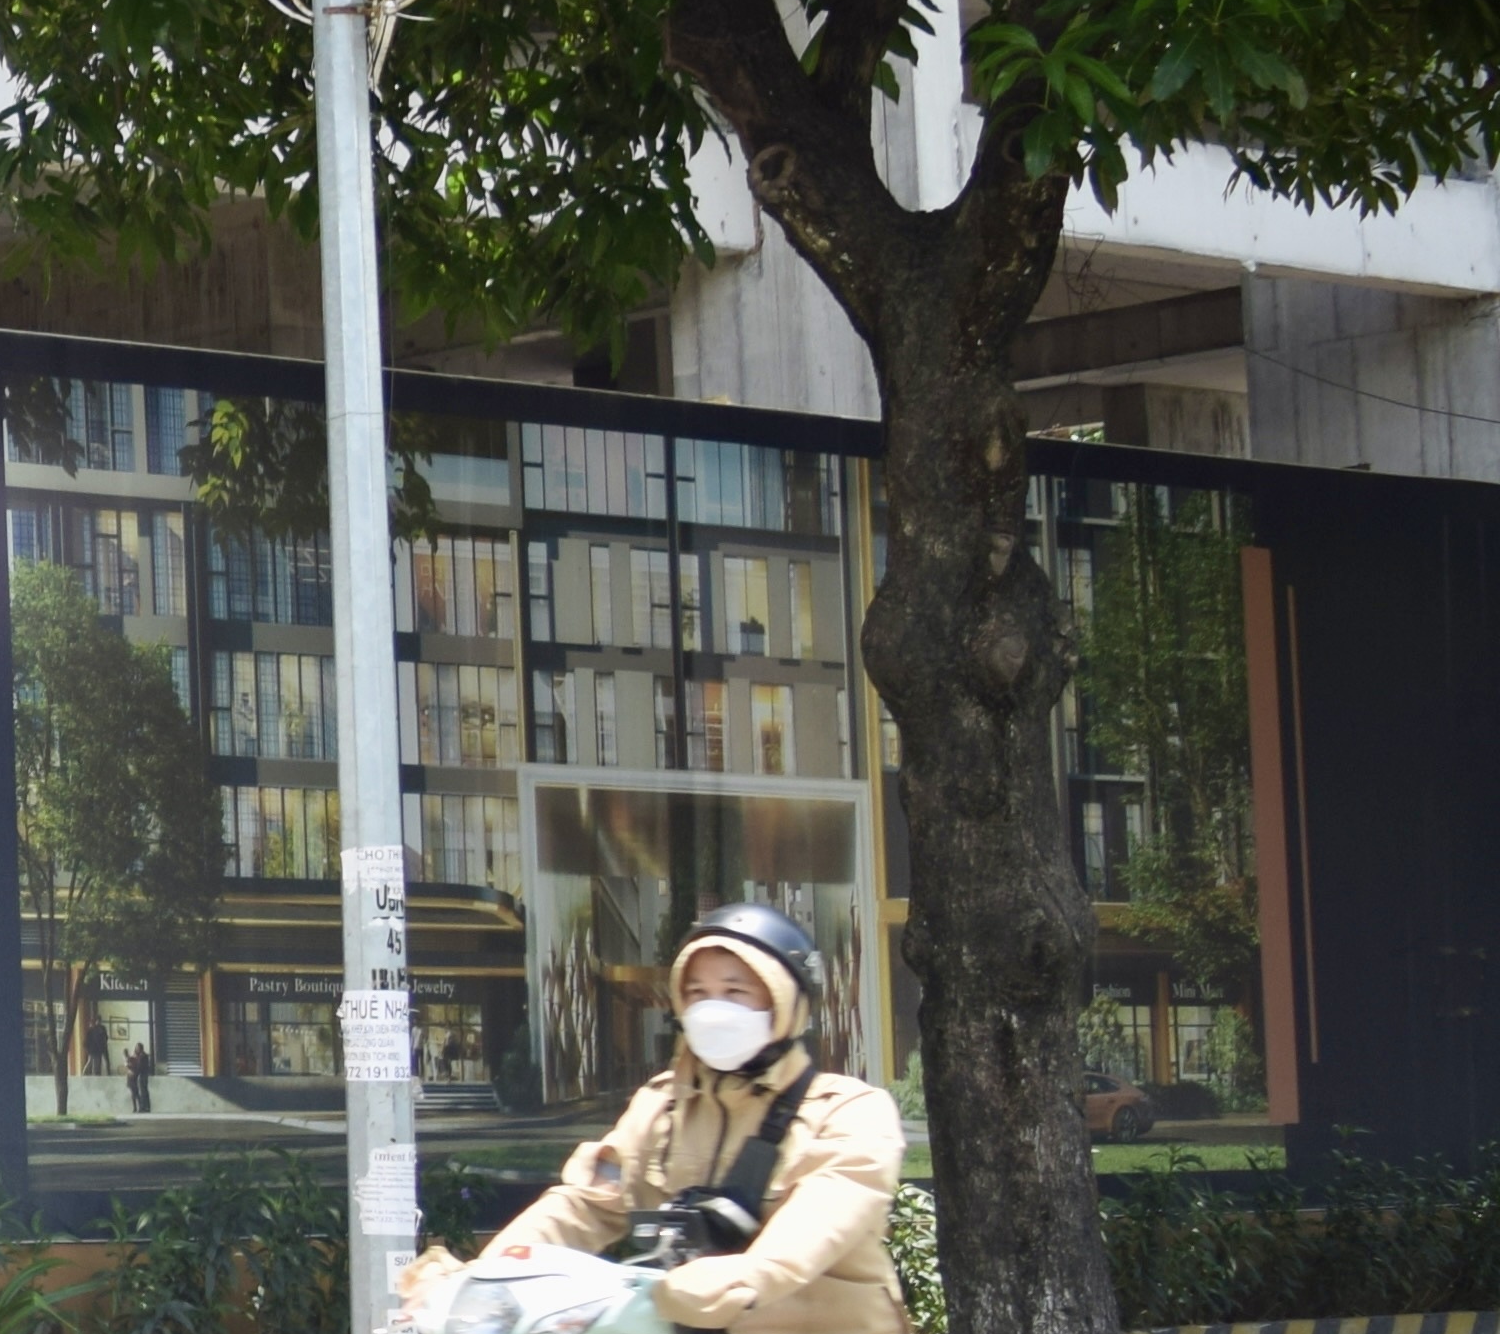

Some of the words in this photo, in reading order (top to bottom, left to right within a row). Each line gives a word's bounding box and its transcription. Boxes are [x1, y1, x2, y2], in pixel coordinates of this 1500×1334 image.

[250, 977, 289, 997] Pastry
[294, 977, 344, 998] Boutiqu
[412, 978, 455, 998] Jewelry
[366, 1067, 388, 1078] 191
